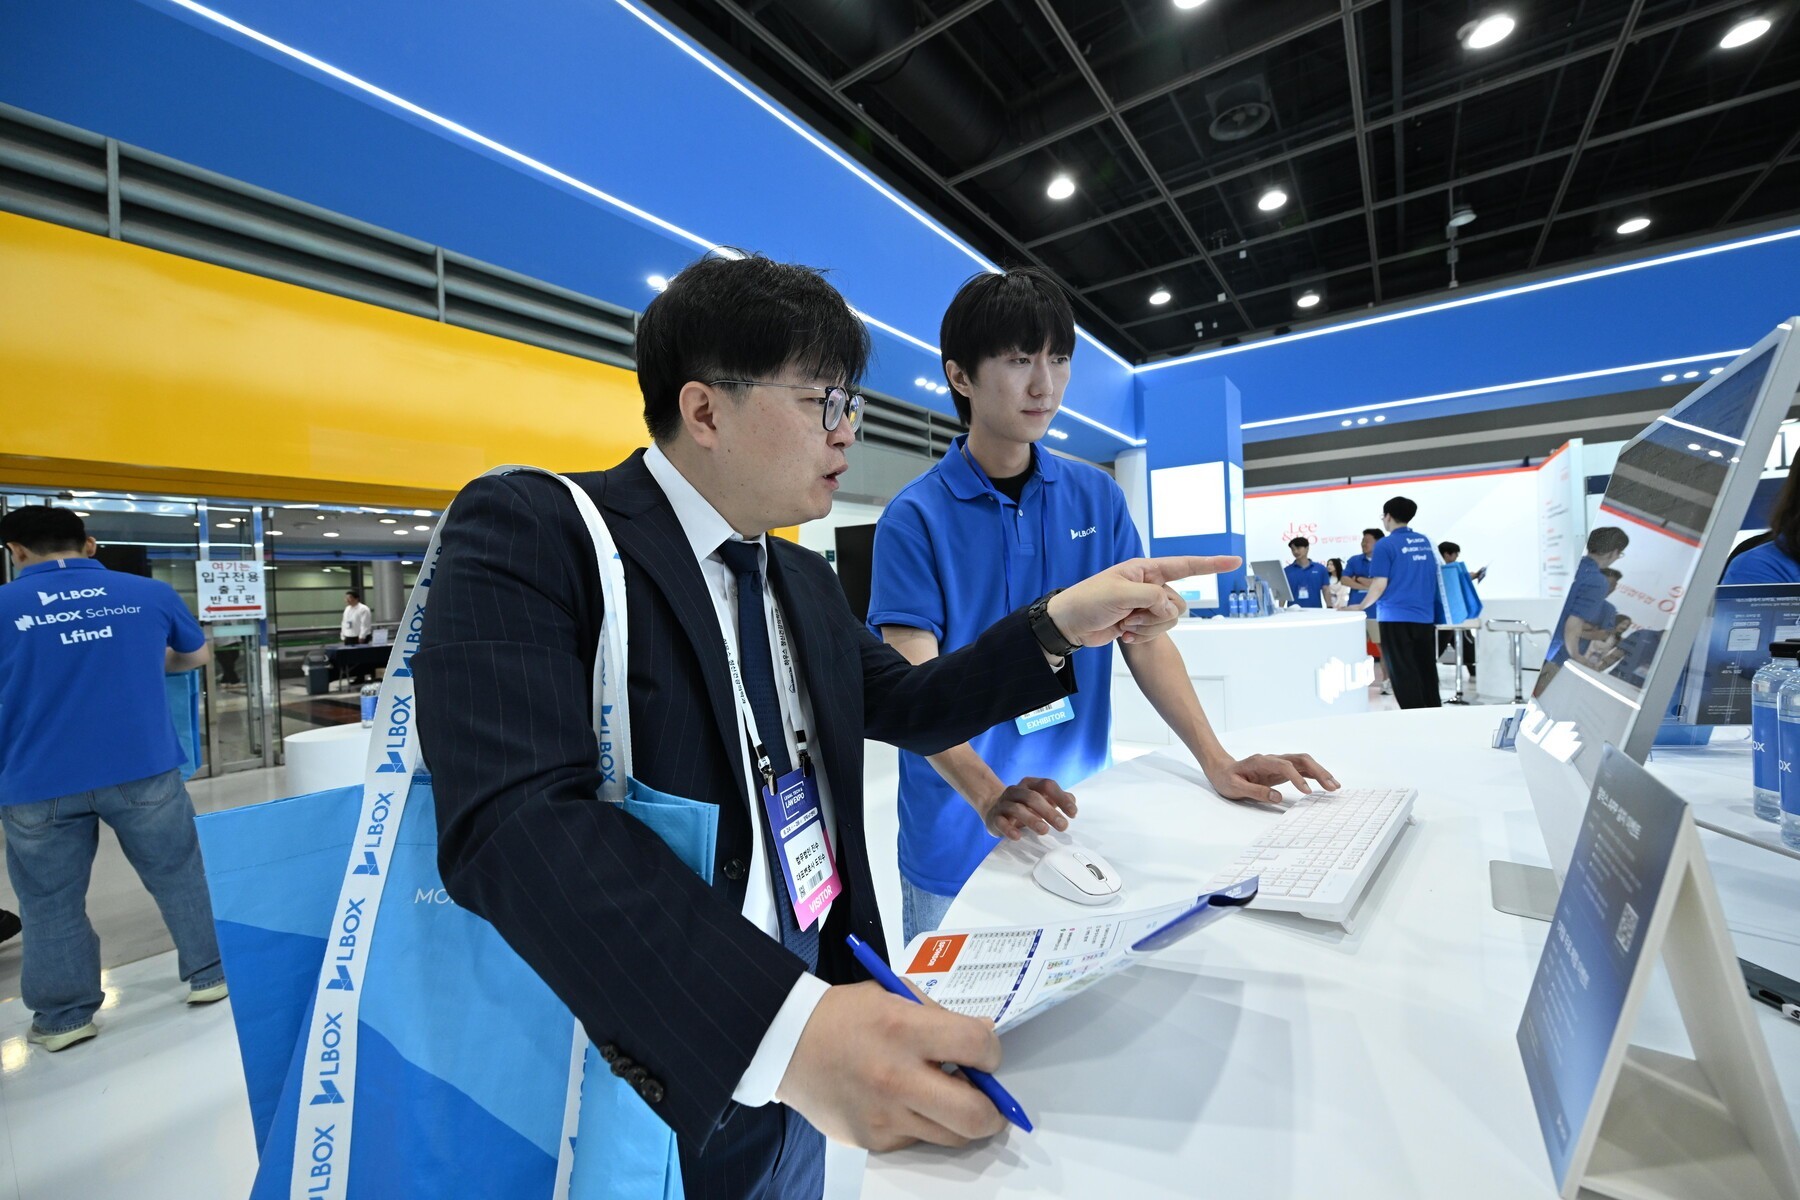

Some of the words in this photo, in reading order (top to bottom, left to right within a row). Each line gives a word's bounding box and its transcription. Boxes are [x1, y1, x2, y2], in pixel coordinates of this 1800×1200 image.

[1078, 526, 1097, 538] LBOX
[1288, 522, 1318, 535] Lee
[201, 572, 260, 583] 입구전용
[212, 562, 251, 572] 여기는
[60, 587, 107, 601] LBOX
[35, 610, 84, 626] LBOX
[86, 604, 142, 619] Scholar
[60, 625, 113, 645] Lfind
[402, 604, 426, 655] LBOX
[386, 694, 414, 750] LBOX
[1026, 711, 1067, 730] EXHIBITOR
[600, 729, 616, 783] LBOX
[364, 792, 395, 848] LBOX
[795, 849, 812, 866] 법무법인
[796, 861, 815, 881] 대표변호사
[414, 888, 454, 905] MO
[809, 885, 833, 914] VISITOR
[335, 898, 366, 961] LBOX
[928, 941, 945, 967] SPONSOR
[320, 1011, 344, 1077] LBOX
[308, 1123, 336, 1194] LBOX
